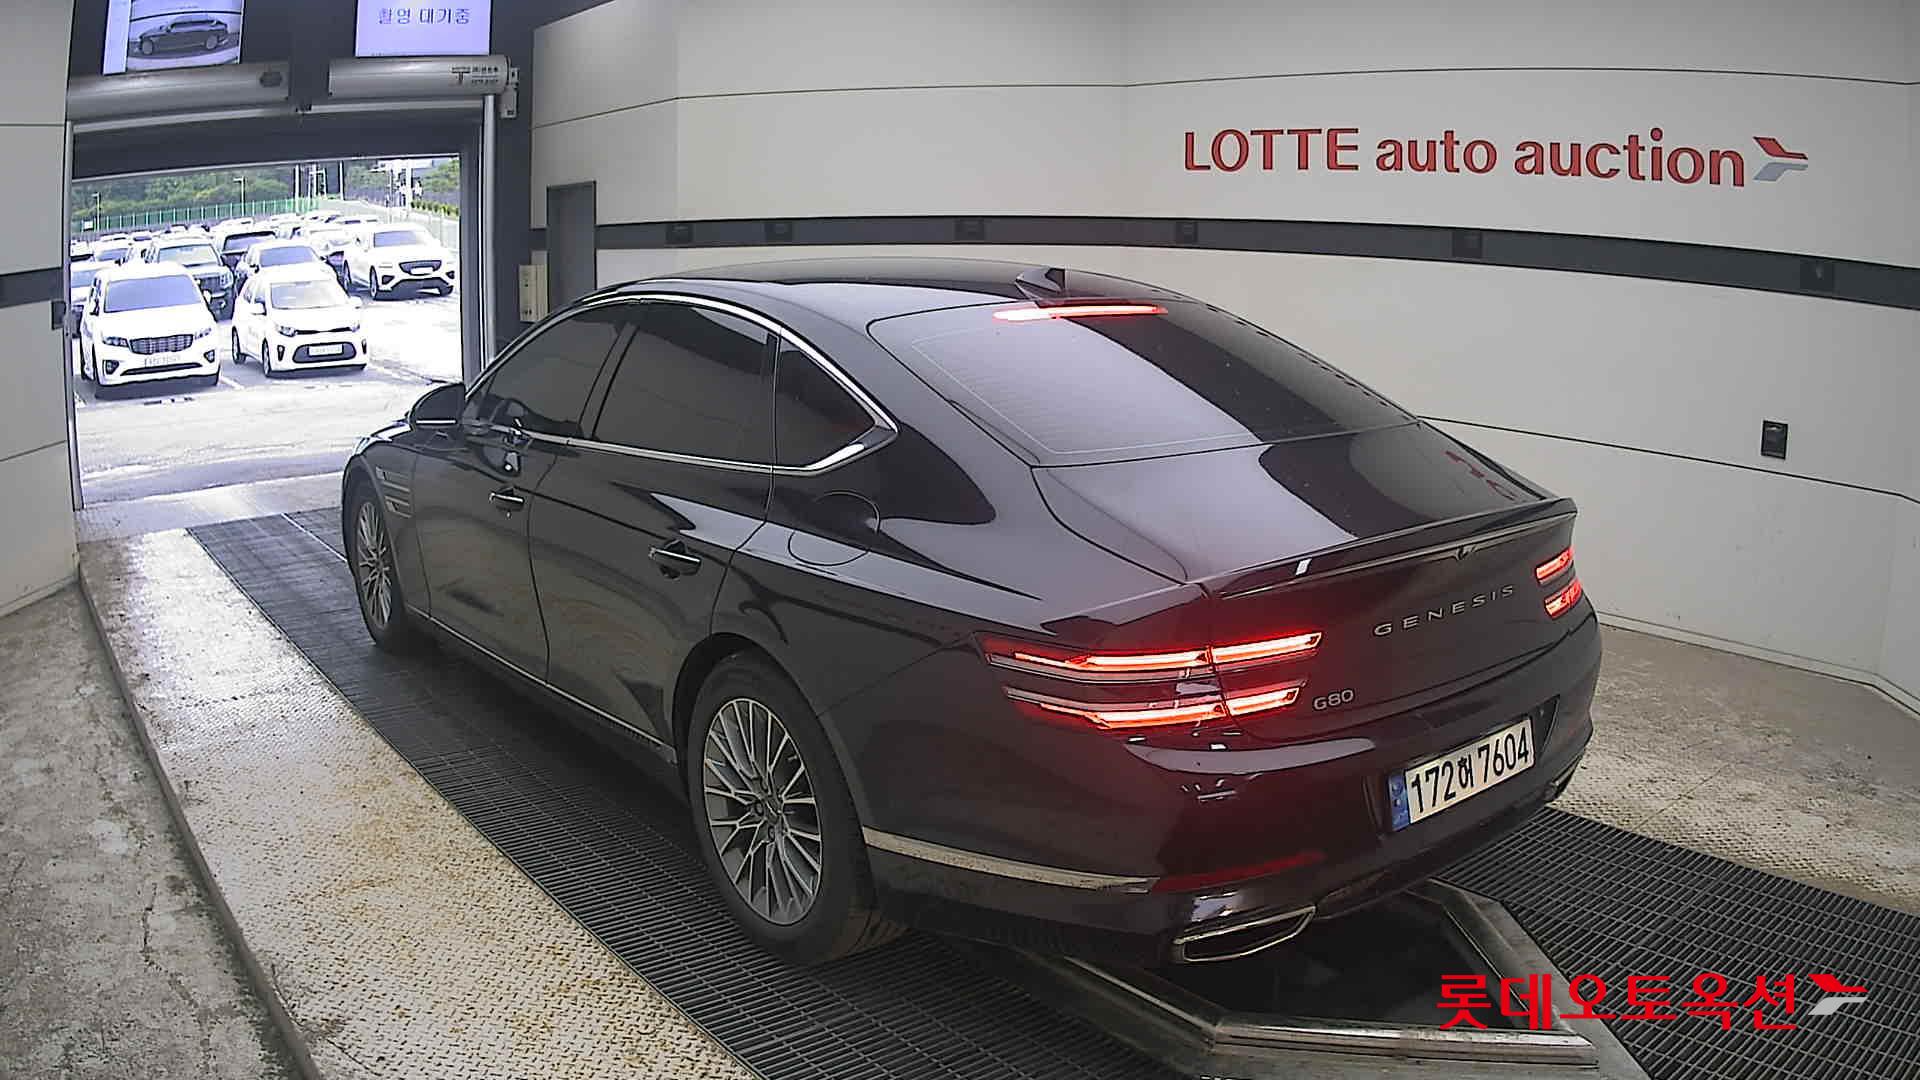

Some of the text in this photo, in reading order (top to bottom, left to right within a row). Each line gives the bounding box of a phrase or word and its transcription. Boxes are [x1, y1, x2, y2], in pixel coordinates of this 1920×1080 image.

[419, 8, 471, 24] 대기중
[1184, 127, 1745, 187] LOTTE auto auction
[1373, 585, 1514, 636] GENESIS
[1312, 689, 1355, 711] G80
[1477, 727, 1529, 784] 7604
